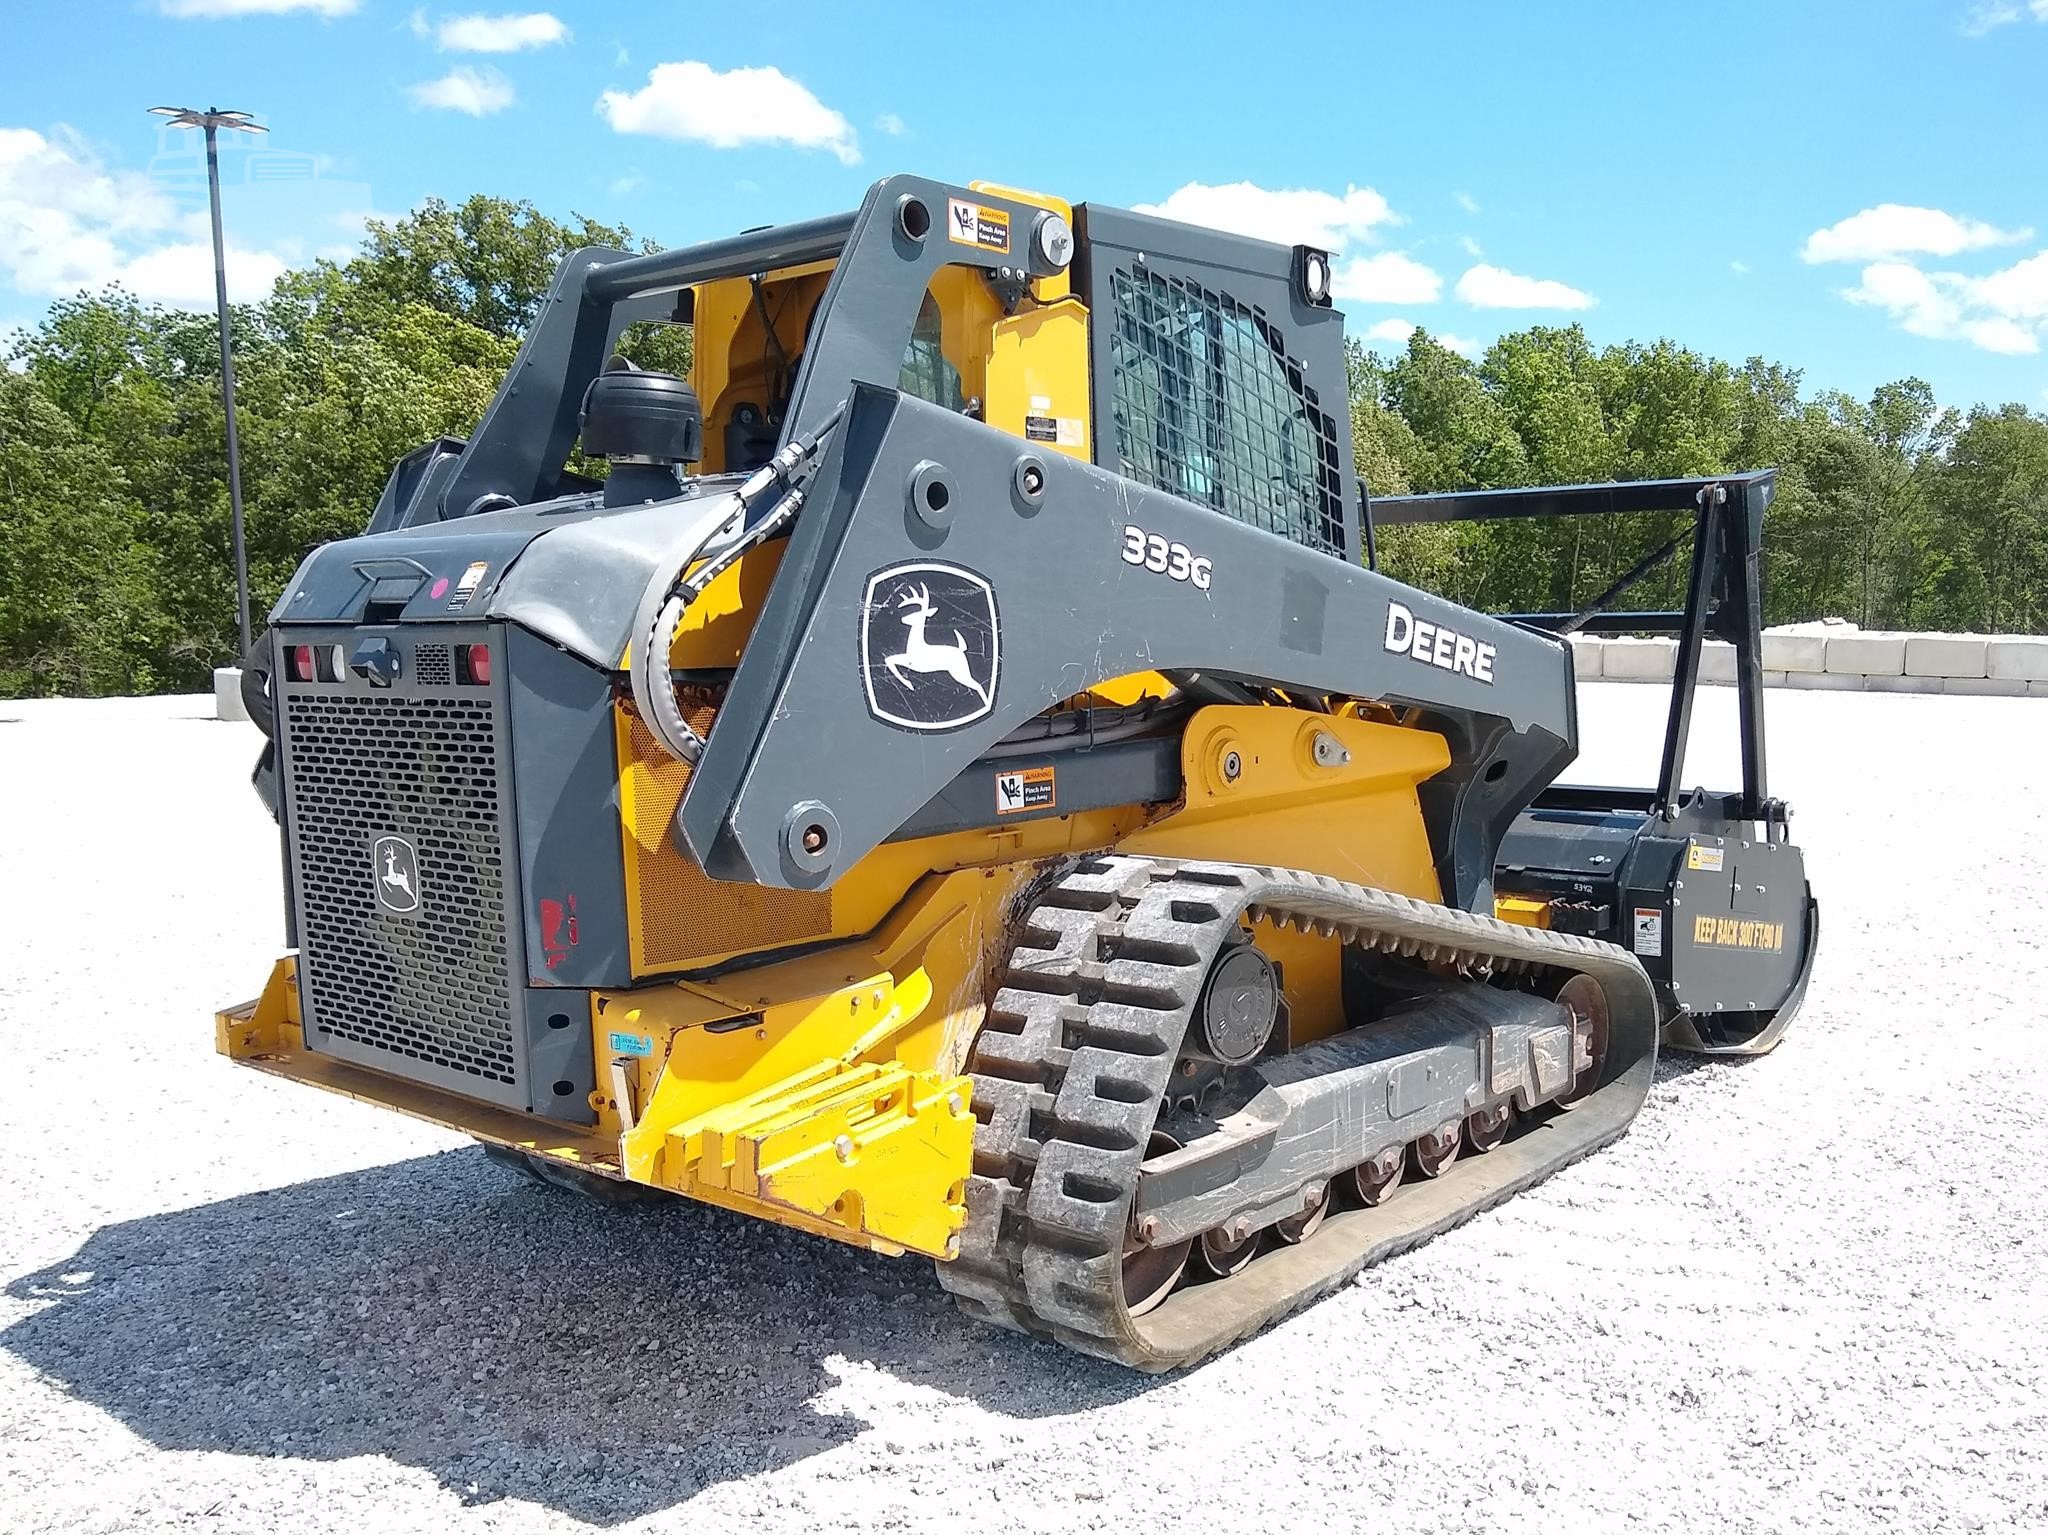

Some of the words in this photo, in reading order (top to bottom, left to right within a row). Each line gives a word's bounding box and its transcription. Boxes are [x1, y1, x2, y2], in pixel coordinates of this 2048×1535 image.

[979, 223, 993, 234] Pinch
[994, 227, 1006, 237] Area
[1121, 524, 1213, 591] 333G
[1384, 600, 1496, 685] DEERE
[1025, 787, 1039, 795] Pinch
[1040, 785, 1051, 793] Area
[1694, 915, 1716, 943] KEEP
[1717, 918, 1739, 945] BACK
[1738, 921, 1754, 947] 300
